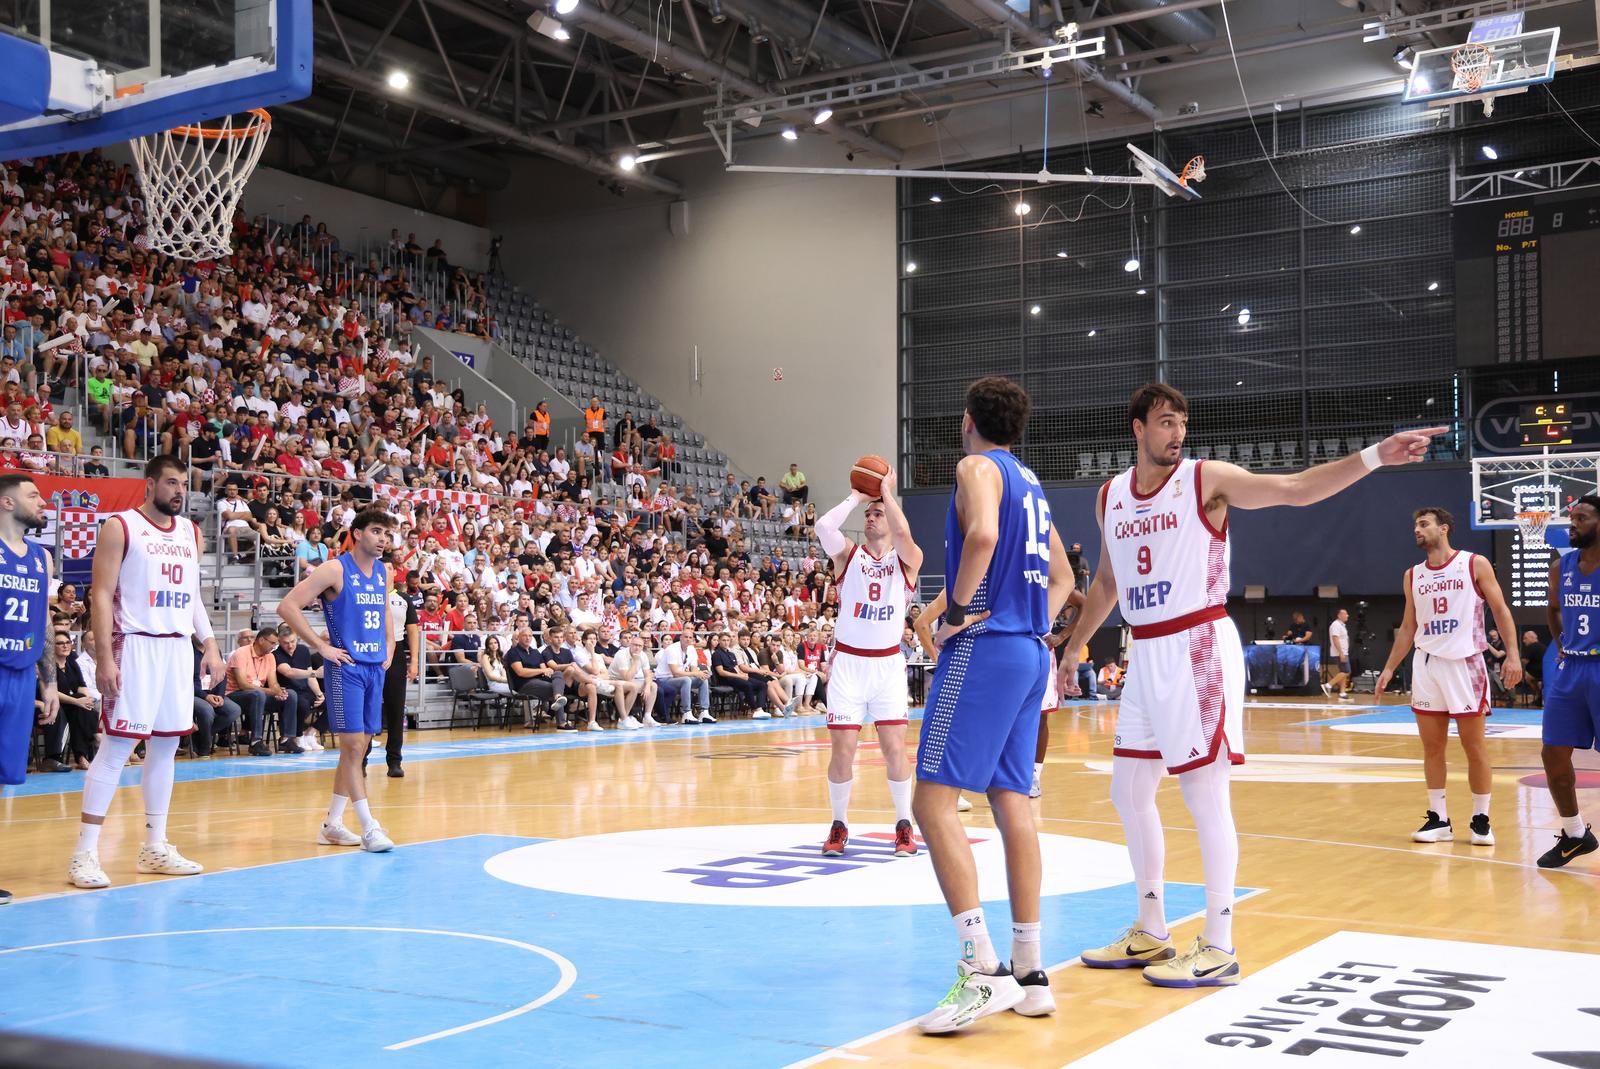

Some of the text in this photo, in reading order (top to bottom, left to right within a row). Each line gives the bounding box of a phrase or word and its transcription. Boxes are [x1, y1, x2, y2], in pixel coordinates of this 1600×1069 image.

[1505, 210, 1529, 219] HOME
[1522, 240, 1537, 248] P/T
[1022, 491, 1050, 561] 15
[1115, 511, 1178, 539] CROATIA
[147, 542, 192, 559] CROATIA
[1137, 545, 1152, 575] 9
[0, 573, 41, 593] ISRAEL
[161, 564, 184, 585] 40
[868, 583, 881, 602] 8
[1134, 580, 1172, 610] HEP
[1418, 579, 1464, 596] CROATIA
[165, 591, 191, 609] HEP
[356, 593, 385, 605] ISRAEL
[1564, 594, 1600, 608] ISRAE
[4, 597, 30, 622] 21
[867, 604, 895, 622] HEP
[364, 610, 381, 629] 33
[1430, 619, 1459, 635] HEP
[1577, 614, 1590, 636] 3
[353, 640, 379, 652] הראל
[964, 916, 981, 927] 23
[1204, 961, 1397, 1049] LEASING
[1281, 968, 1507, 1058] MOBIL
